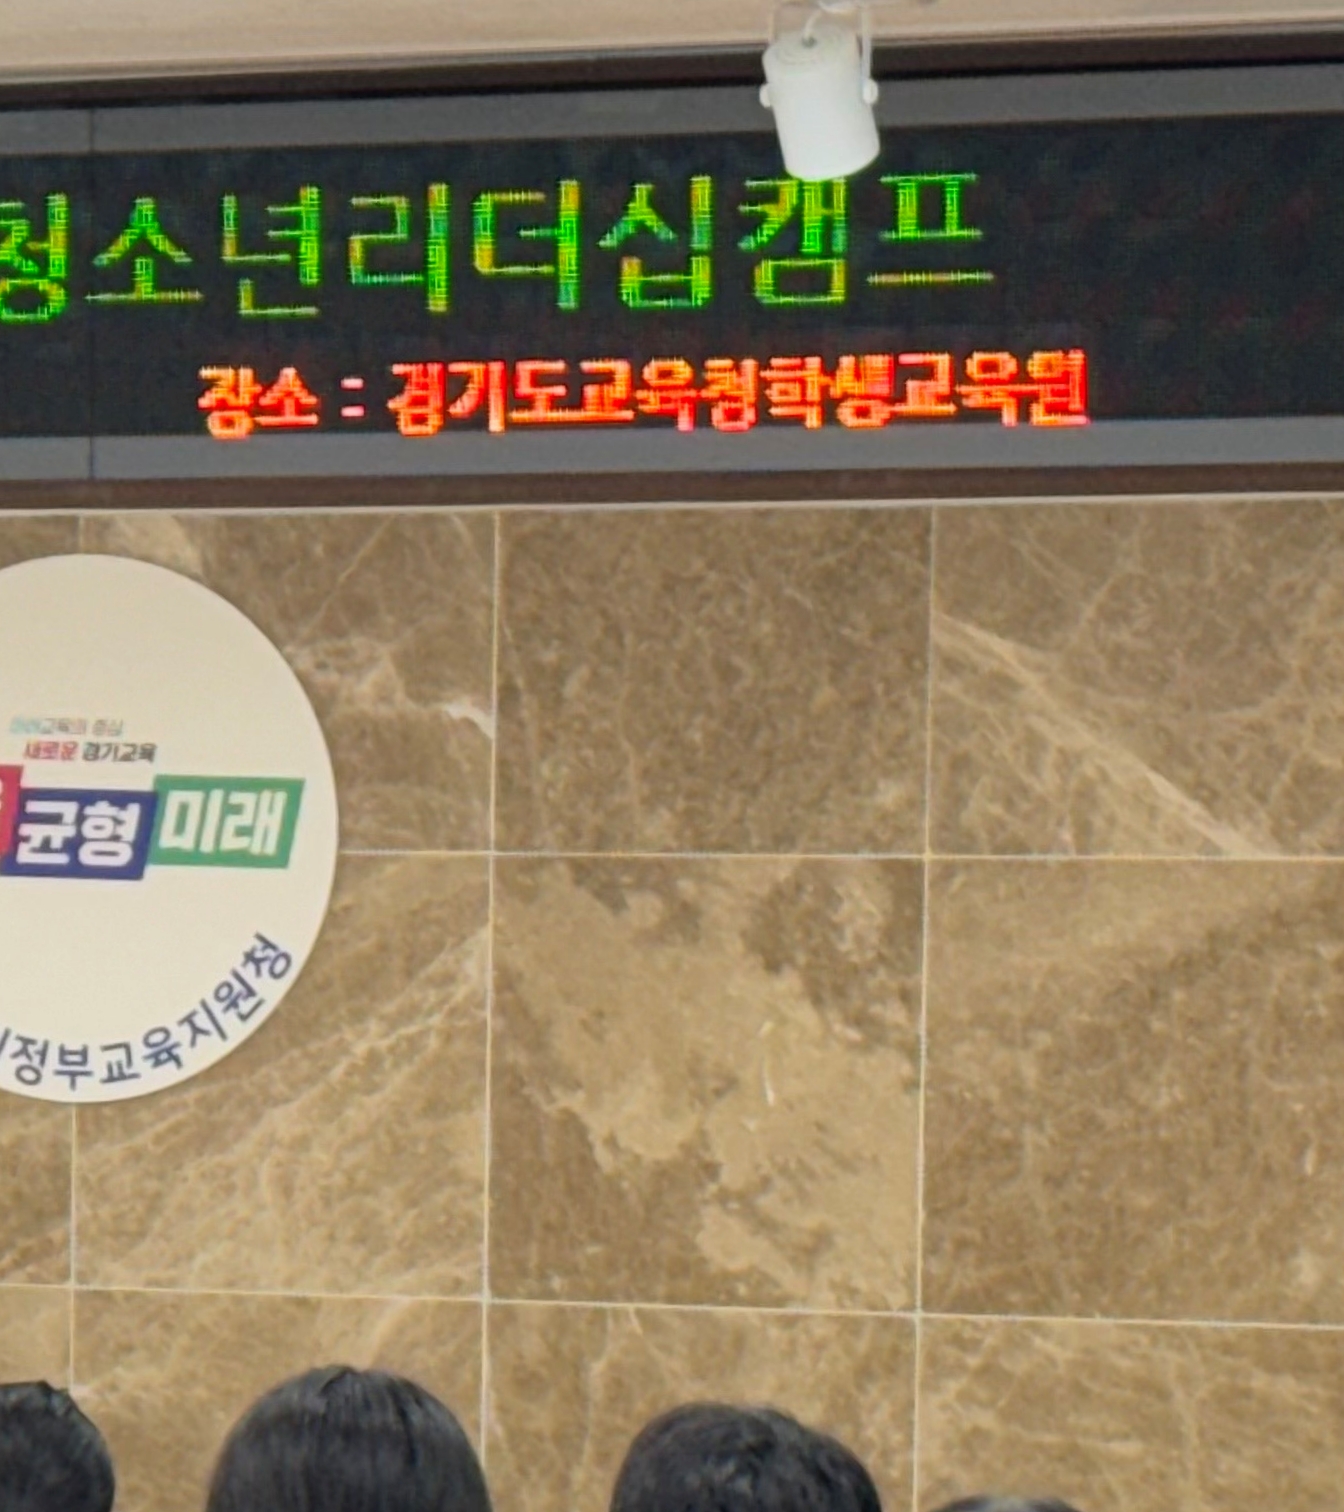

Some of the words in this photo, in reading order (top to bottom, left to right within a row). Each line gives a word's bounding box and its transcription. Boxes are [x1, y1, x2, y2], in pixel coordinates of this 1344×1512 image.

[198, 364, 320, 439] 장소
[16, 799, 142, 868] 균형
[158, 788, 288, 856] 미래
